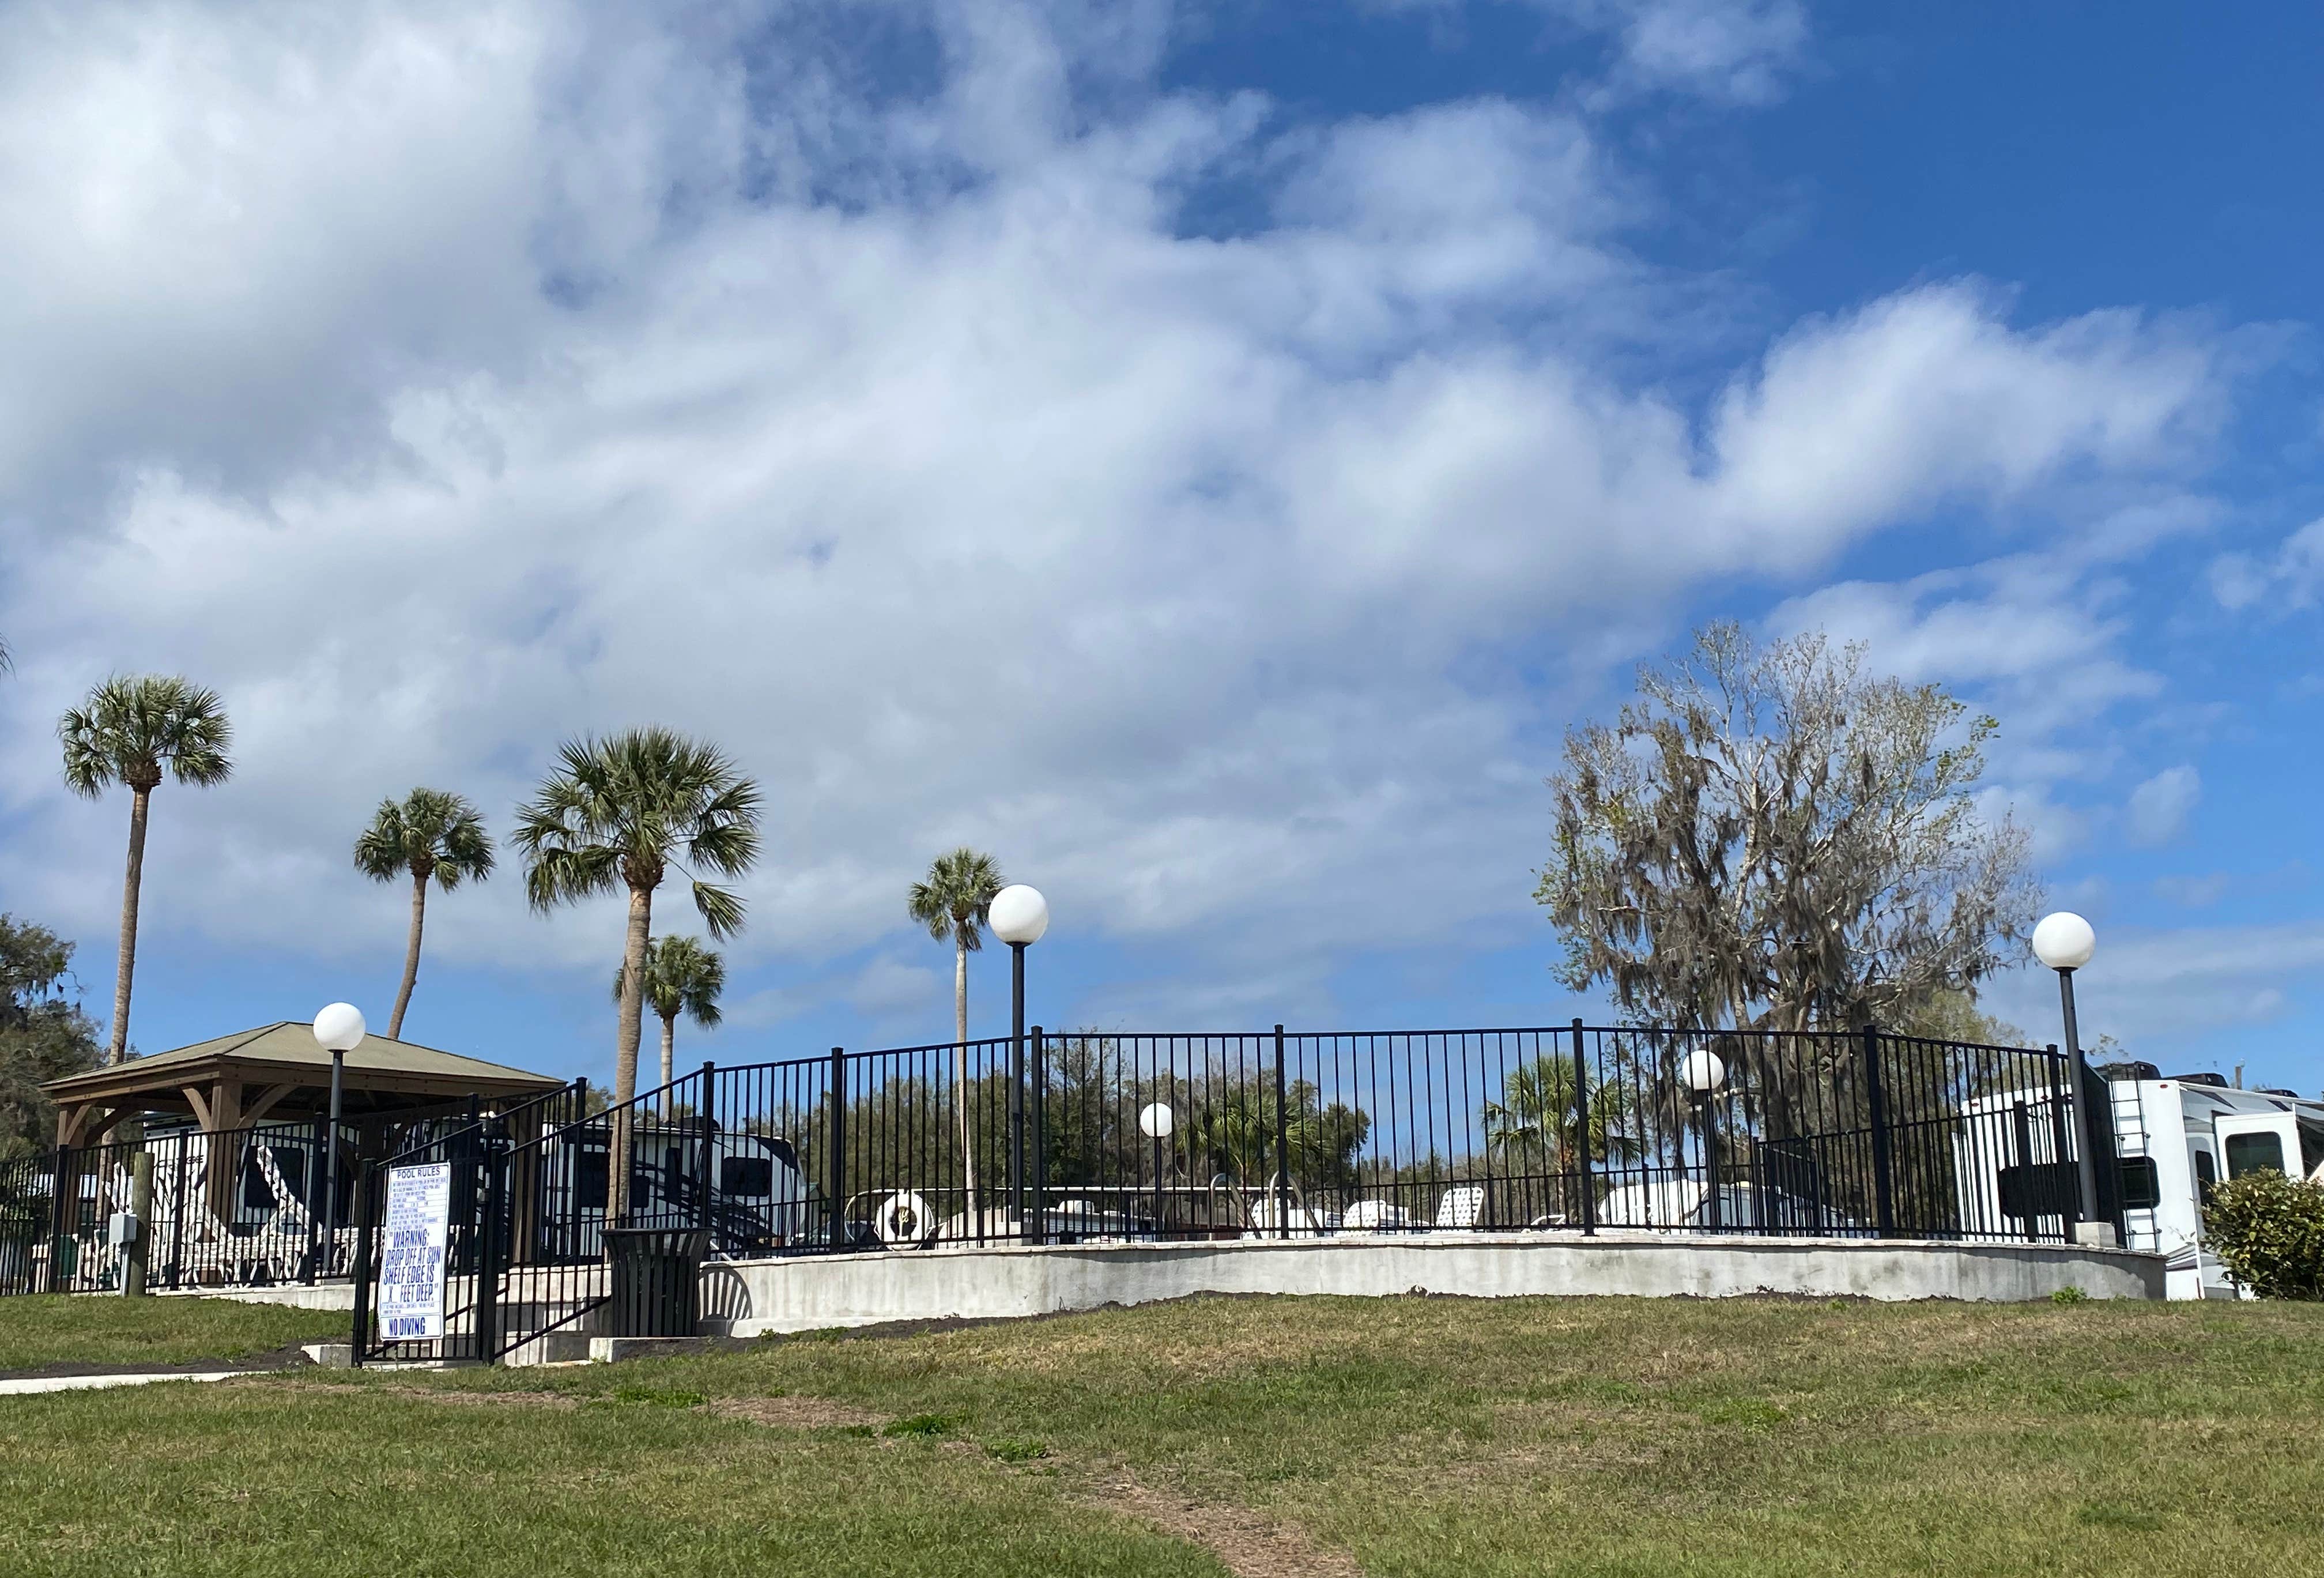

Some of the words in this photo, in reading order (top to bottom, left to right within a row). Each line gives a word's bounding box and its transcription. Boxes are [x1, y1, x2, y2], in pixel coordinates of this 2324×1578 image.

[397, 1170, 415, 1178] POOL
[417, 1167, 440, 1177] RULES
[386, 1249, 404, 1267] DROP
[405, 1248, 417, 1266] OFF
[418, 1247, 427, 1264] AT
[427, 1245, 441, 1264] SUN
[383, 1266, 406, 1285] SHELF
[407, 1265, 425, 1284] EDGE
[427, 1264, 435, 1283] IS
[401, 1284, 415, 1302] FEET
[389, 1318, 398, 1336] NO
[399, 1317, 425, 1336] DIVING
